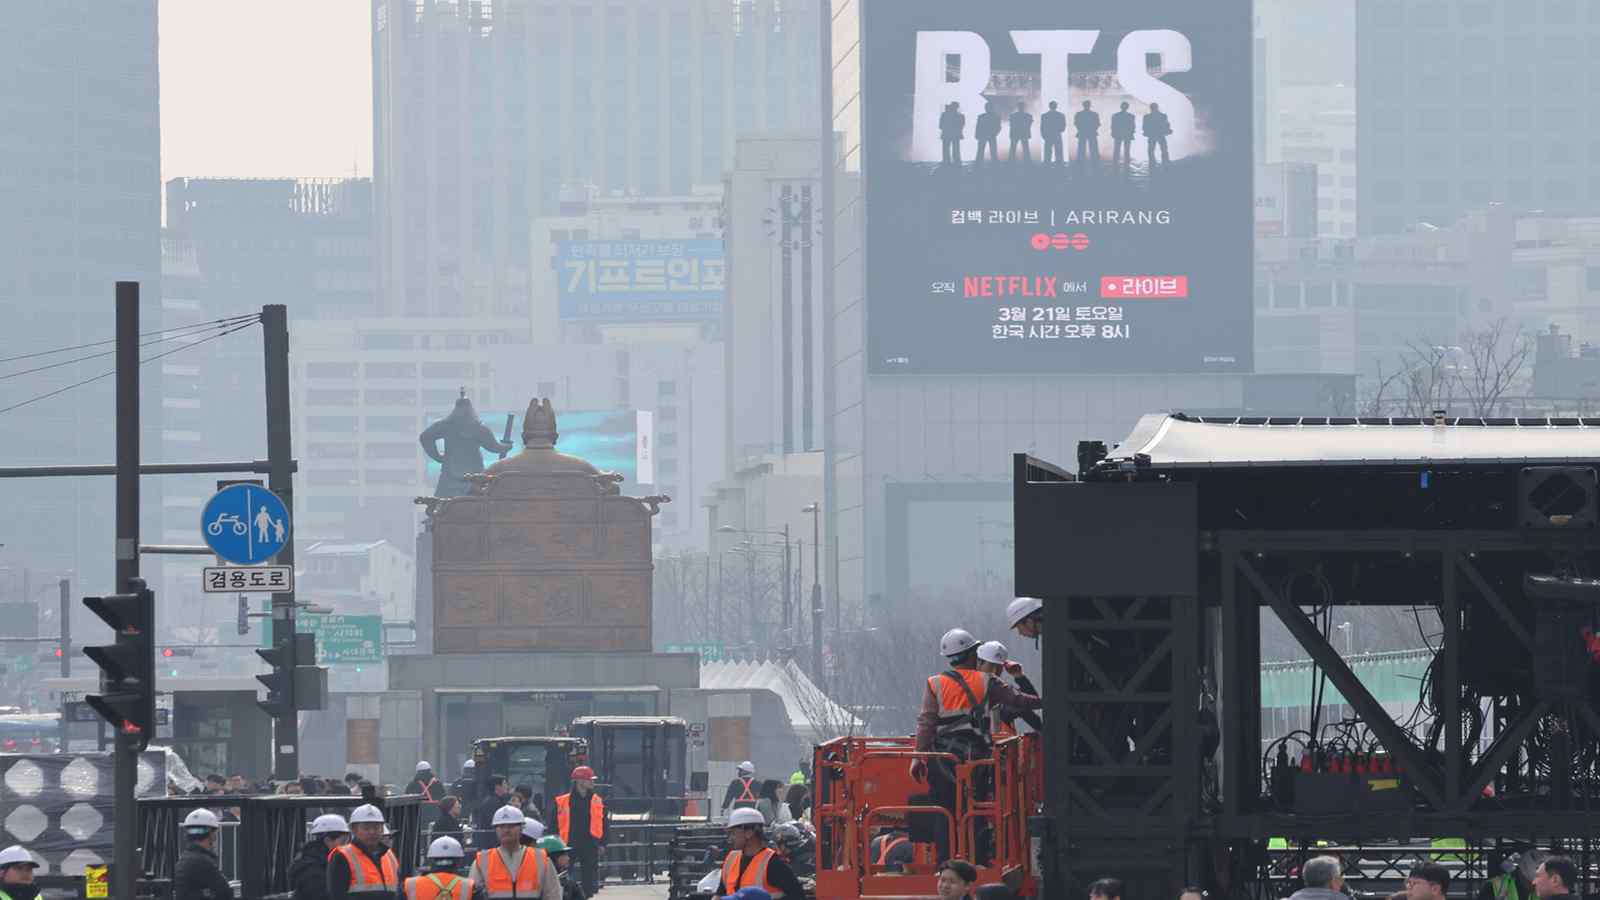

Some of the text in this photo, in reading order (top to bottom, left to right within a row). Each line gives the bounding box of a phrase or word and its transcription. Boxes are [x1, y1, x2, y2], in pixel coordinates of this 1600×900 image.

[911, 29, 1195, 163] BTS
[952, 208, 985, 224] 컴백
[989, 208, 1040, 224] 라이브
[932, 276, 1176, 296] 오직 NETFLIX 에서 라이브
[998, 306, 1123, 322] 3월 21일 토요일
[992, 323, 1130, 339] 한국 시간 오후 8시
[210, 571, 285, 588] 겸용도로
